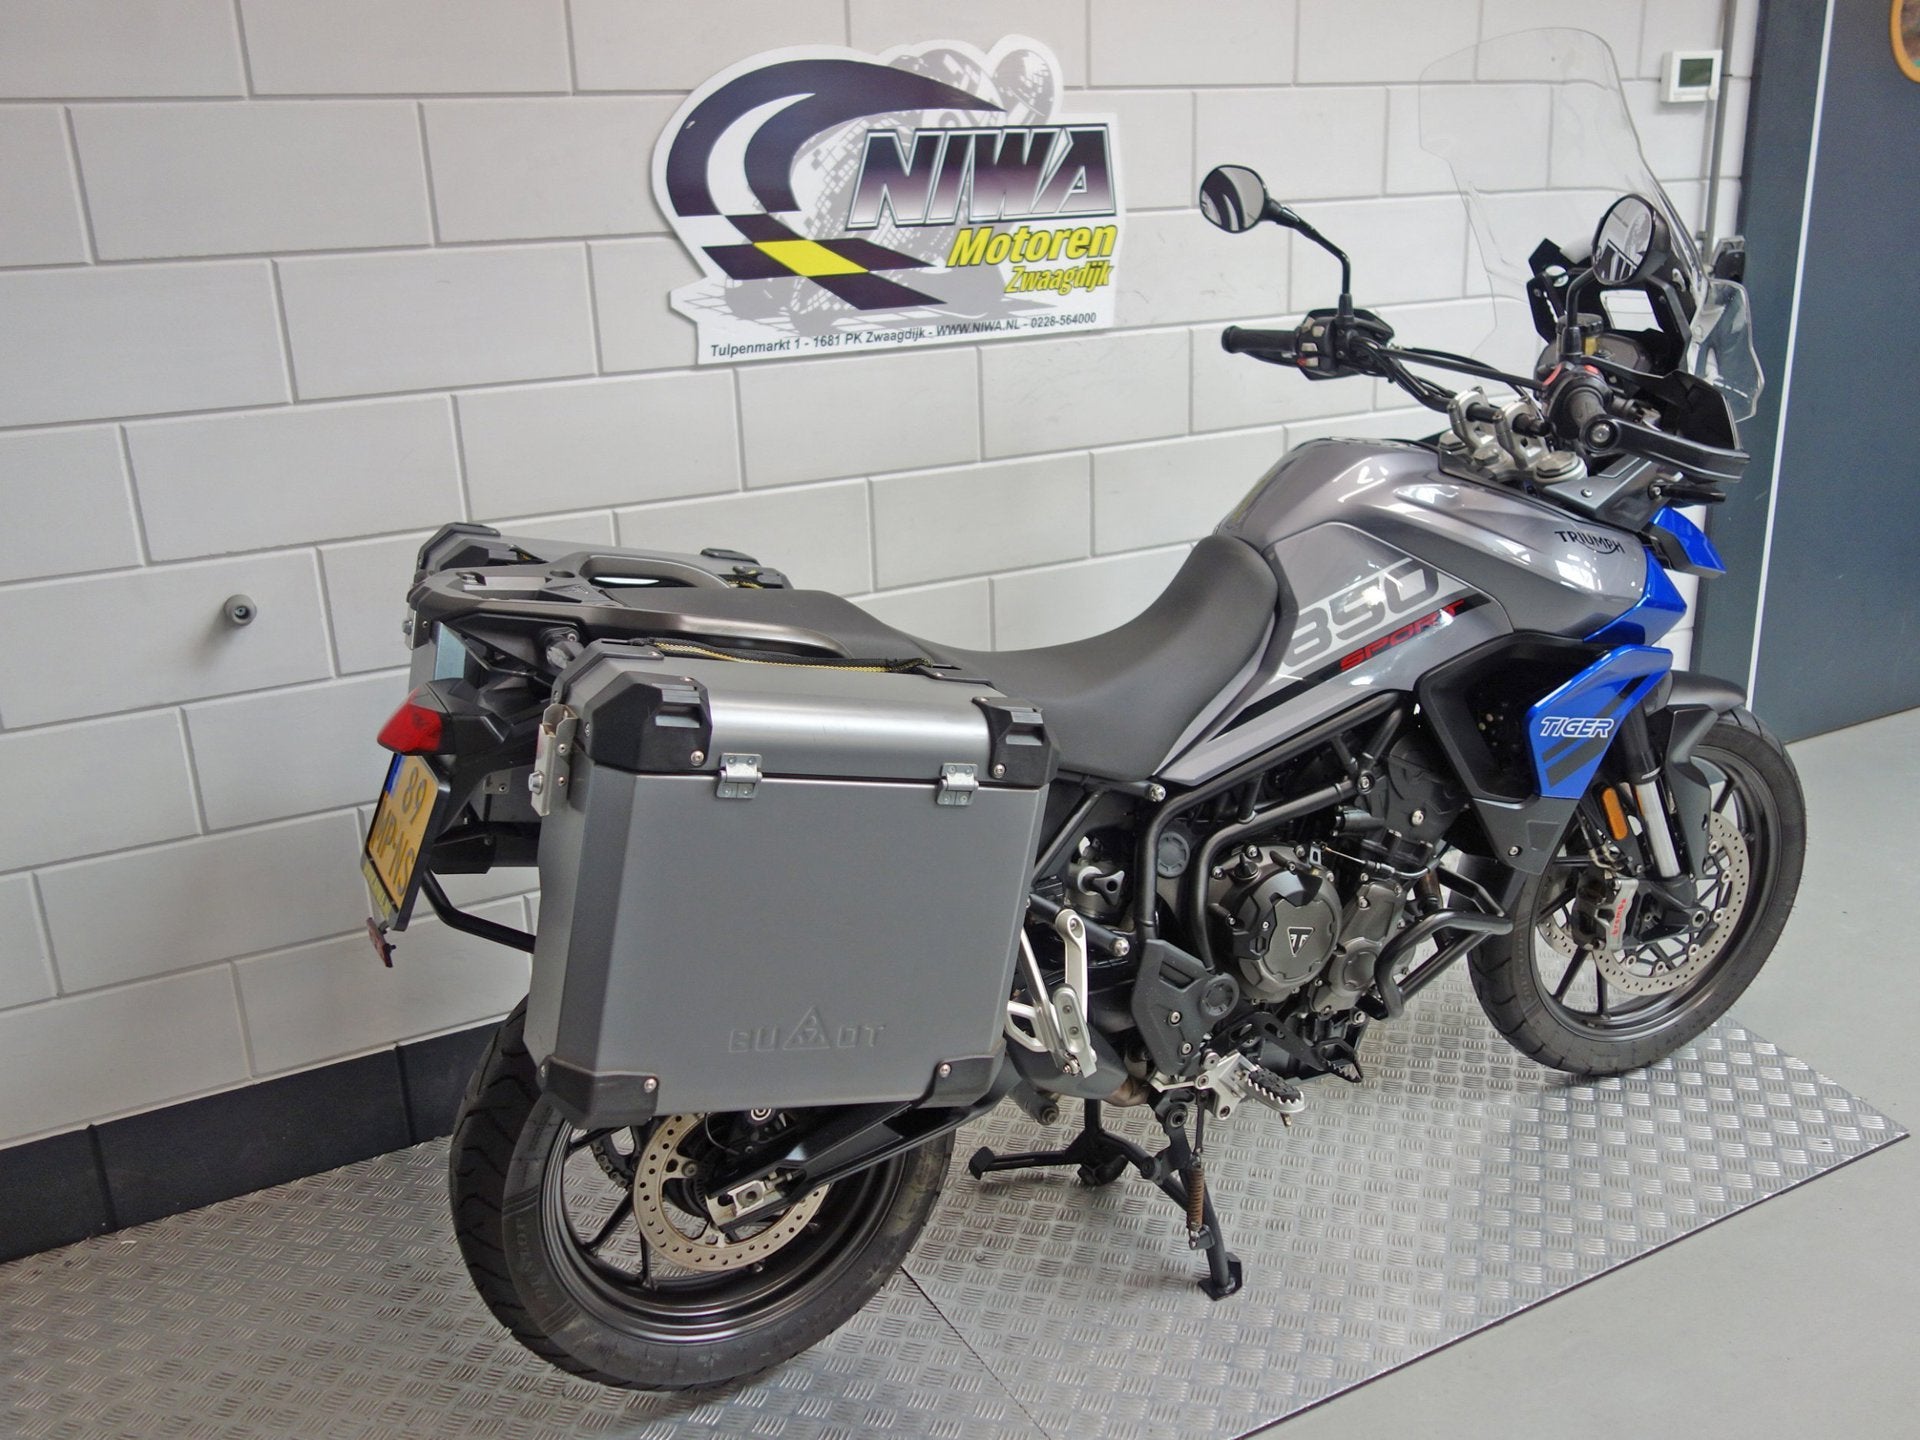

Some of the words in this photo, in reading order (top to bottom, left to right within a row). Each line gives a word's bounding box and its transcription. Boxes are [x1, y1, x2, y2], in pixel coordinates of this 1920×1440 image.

[846, 123, 1118, 231] NIWA
[946, 224, 1118, 268] Motoren
[1004, 260, 1113, 296] Zwaagdijk
[711, 338, 791, 358] Tulpenmarkt
[813, 335, 841, 348] 1681
[845, 333, 863, 345] PK
[866, 327, 925, 343] Zwaagdijk
[936, 318, 1021, 337] WWW.NIWA.NL
[1030, 312, 1097, 328] 0228-564000
[1554, 530, 1626, 554] TRIUMPH
[1284, 559, 1440, 667] 850
[1339, 599, 1466, 672] SPORT
[1540, 716, 1616, 739] TIGER
[402, 766, 428, 825] 89
